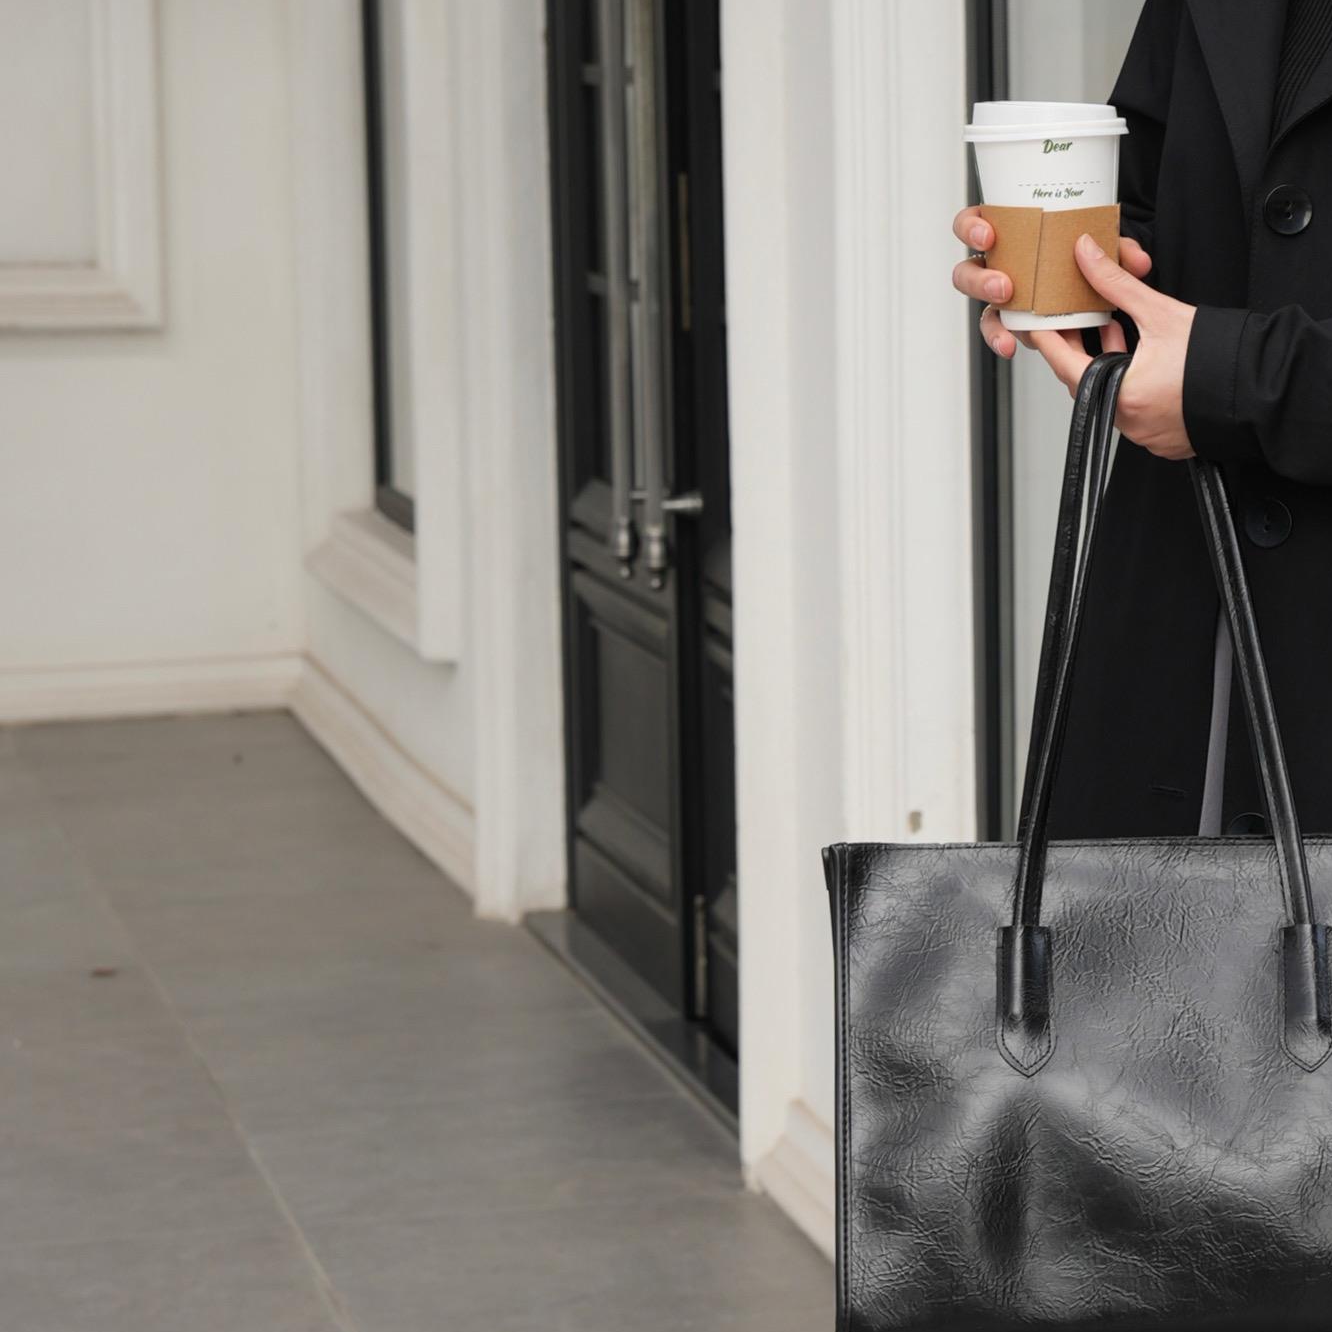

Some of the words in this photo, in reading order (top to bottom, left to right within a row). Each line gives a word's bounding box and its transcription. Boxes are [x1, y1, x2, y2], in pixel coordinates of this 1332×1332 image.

[1043, 139, 1073, 154] Dear
[1032, 188, 1053, 199] Here
[1055, 188, 1062, 198] is
[1063, 188, 1084, 199] Your
